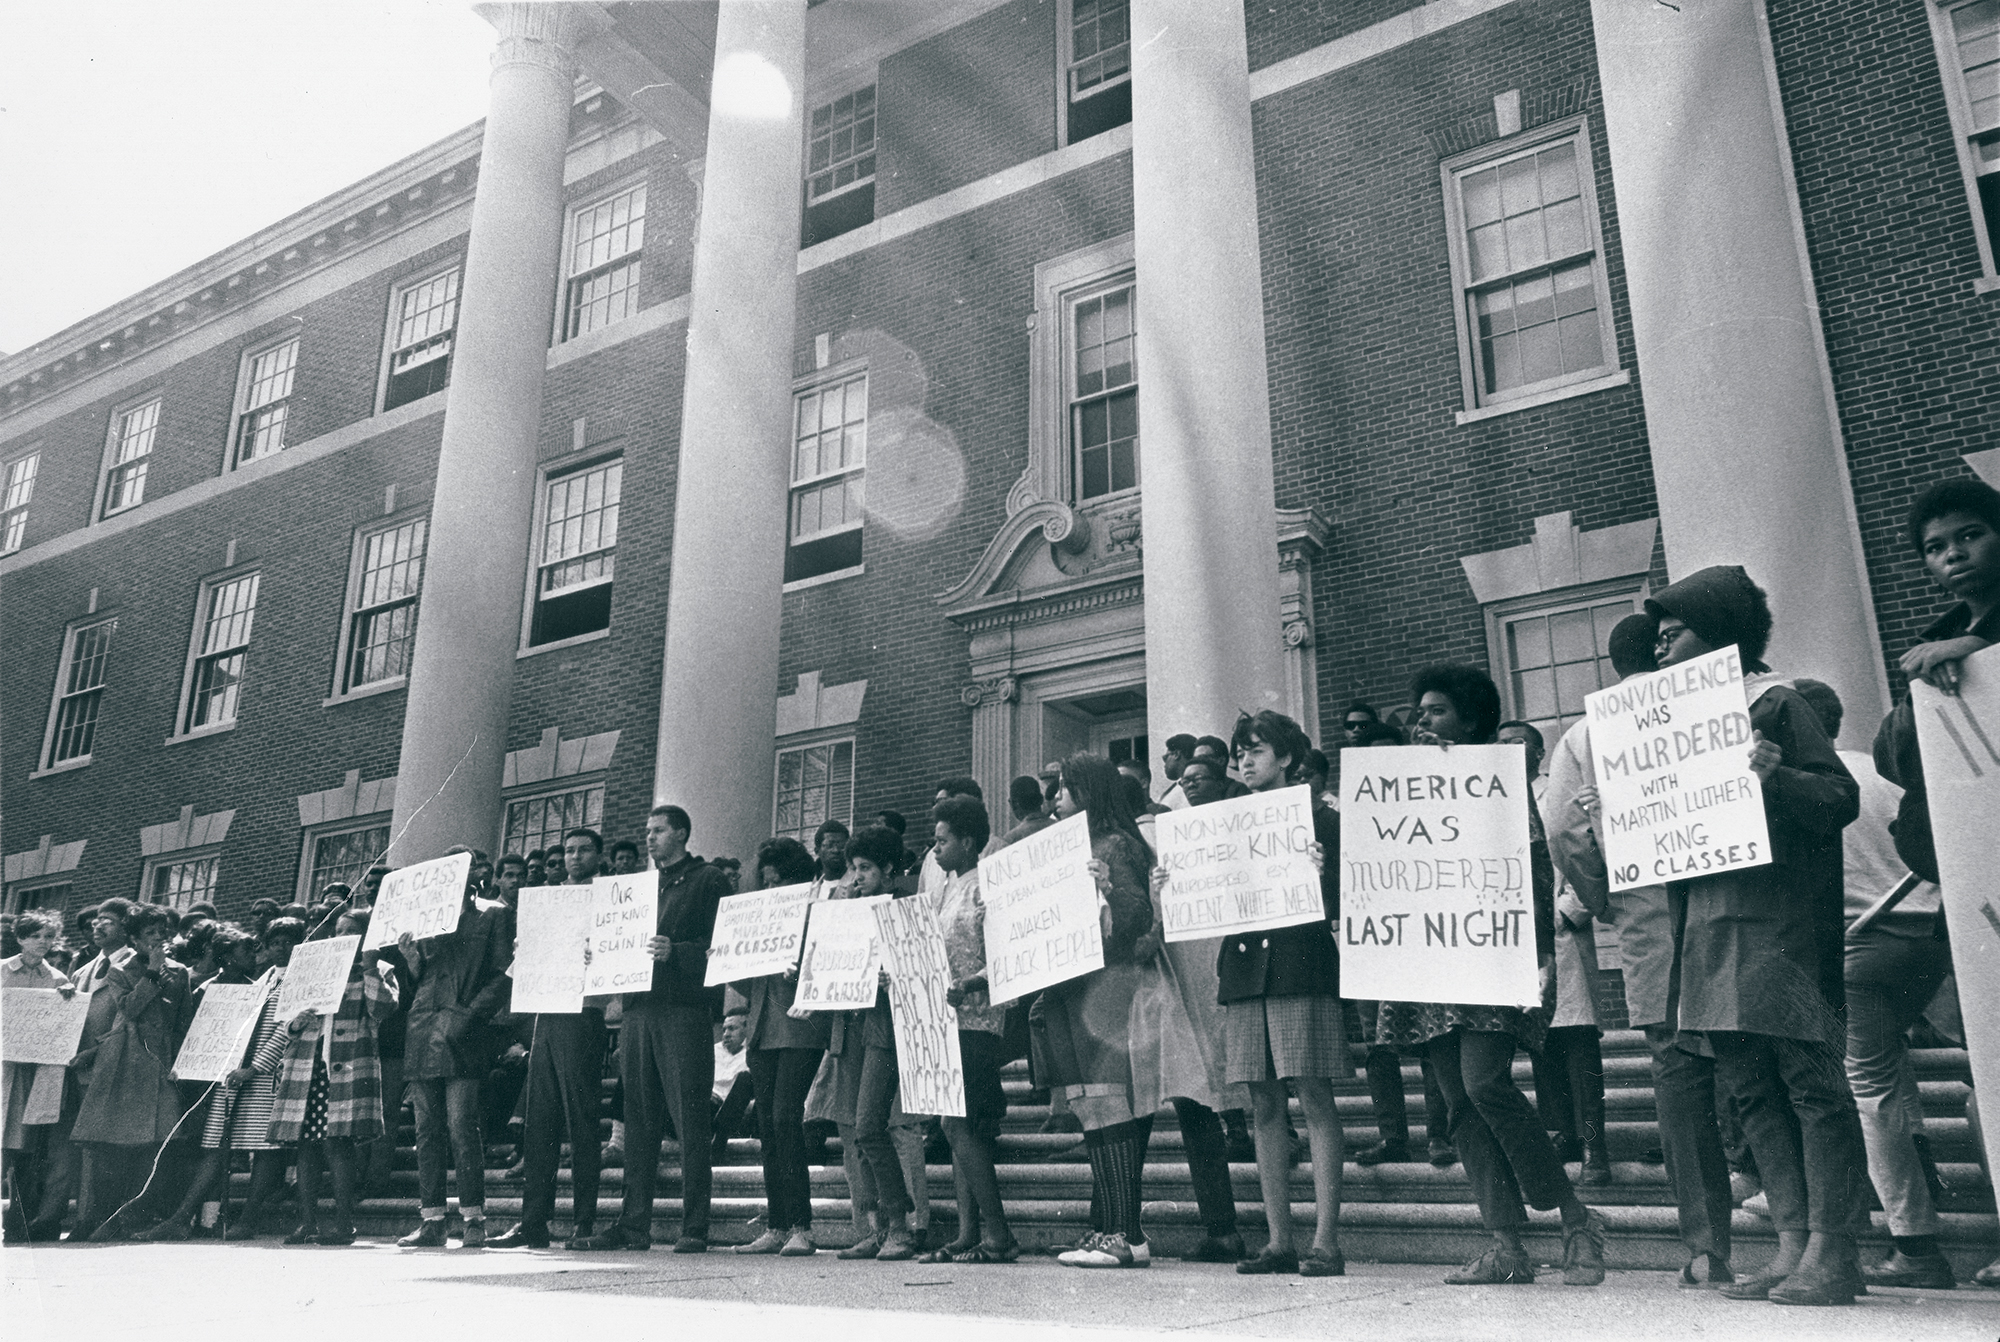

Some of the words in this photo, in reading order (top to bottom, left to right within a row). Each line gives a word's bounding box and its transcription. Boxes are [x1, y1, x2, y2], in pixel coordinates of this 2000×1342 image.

[1593, 654, 1741, 721] NONVIOLENCE
[1635, 705, 1671, 730] WAS
[1603, 713, 1750, 780] MURDERED
[1355, 774, 1508, 803] AMERICA
[1610, 801, 1676, 835] MARTIN
[1687, 776, 1753, 813] LUTHER
[1642, 773, 1678, 798] WITH
[1174, 803, 1301, 844] NON-VIOLENT
[1372, 815, 1459, 845] WAS
[1655, 823, 1709, 856] KING
[985, 850, 1021, 891] KING
[1027, 822, 1086, 871] MURDERED
[1163, 843, 1239, 870] BROTHER
[1249, 825, 1309, 859] KING
[1614, 862, 1639, 886] NO
[1654, 841, 1757, 877] CLASSES
[385, 878, 404, 901] NO
[412, 859, 459, 892] CLASS
[986, 899, 1004, 916] THE
[1041, 863, 1075, 889] KILLED
[1171, 871, 1249, 896] MURDERED
[1267, 862, 1291, 878] BY
[377, 893, 422, 920] BROTHER
[378, 914, 400, 946] IS
[416, 904, 456, 937] DEAD
[596, 912, 618, 928] LAST
[622, 904, 649, 921] KING
[720, 897, 765, 913] UNIVERSITY
[724, 909, 763, 927] BROTHER
[871, 901, 900, 946] THE
[1009, 903, 1062, 943] AWAKEN
[1164, 895, 1224, 929] VIOLENT
[1282, 881, 1322, 915] MEN
[598, 938, 635, 953] SLAIN
[615, 926, 623, 936] IS
[716, 943, 730, 957] NO
[734, 933, 797, 956] CLASSES
[732, 921, 782, 939] MURDER
[1346, 913, 1410, 946] LAST
[1424, 909, 1528, 948] NIGHT
[888, 933, 947, 978] DEFERRED
[993, 947, 1039, 988] BLACK
[1046, 923, 1101, 973] PEOPLE
[591, 976, 605, 988] NO
[612, 971, 650, 986] CLASSES
[803, 982, 819, 1001] NO
[825, 979, 872, 1002] CLASSES
[892, 976, 922, 1026] ARE
[920, 971, 956, 1026] YOU
[903, 1022, 950, 1070] READY
[901, 1067, 963, 1116] NIGGER?
